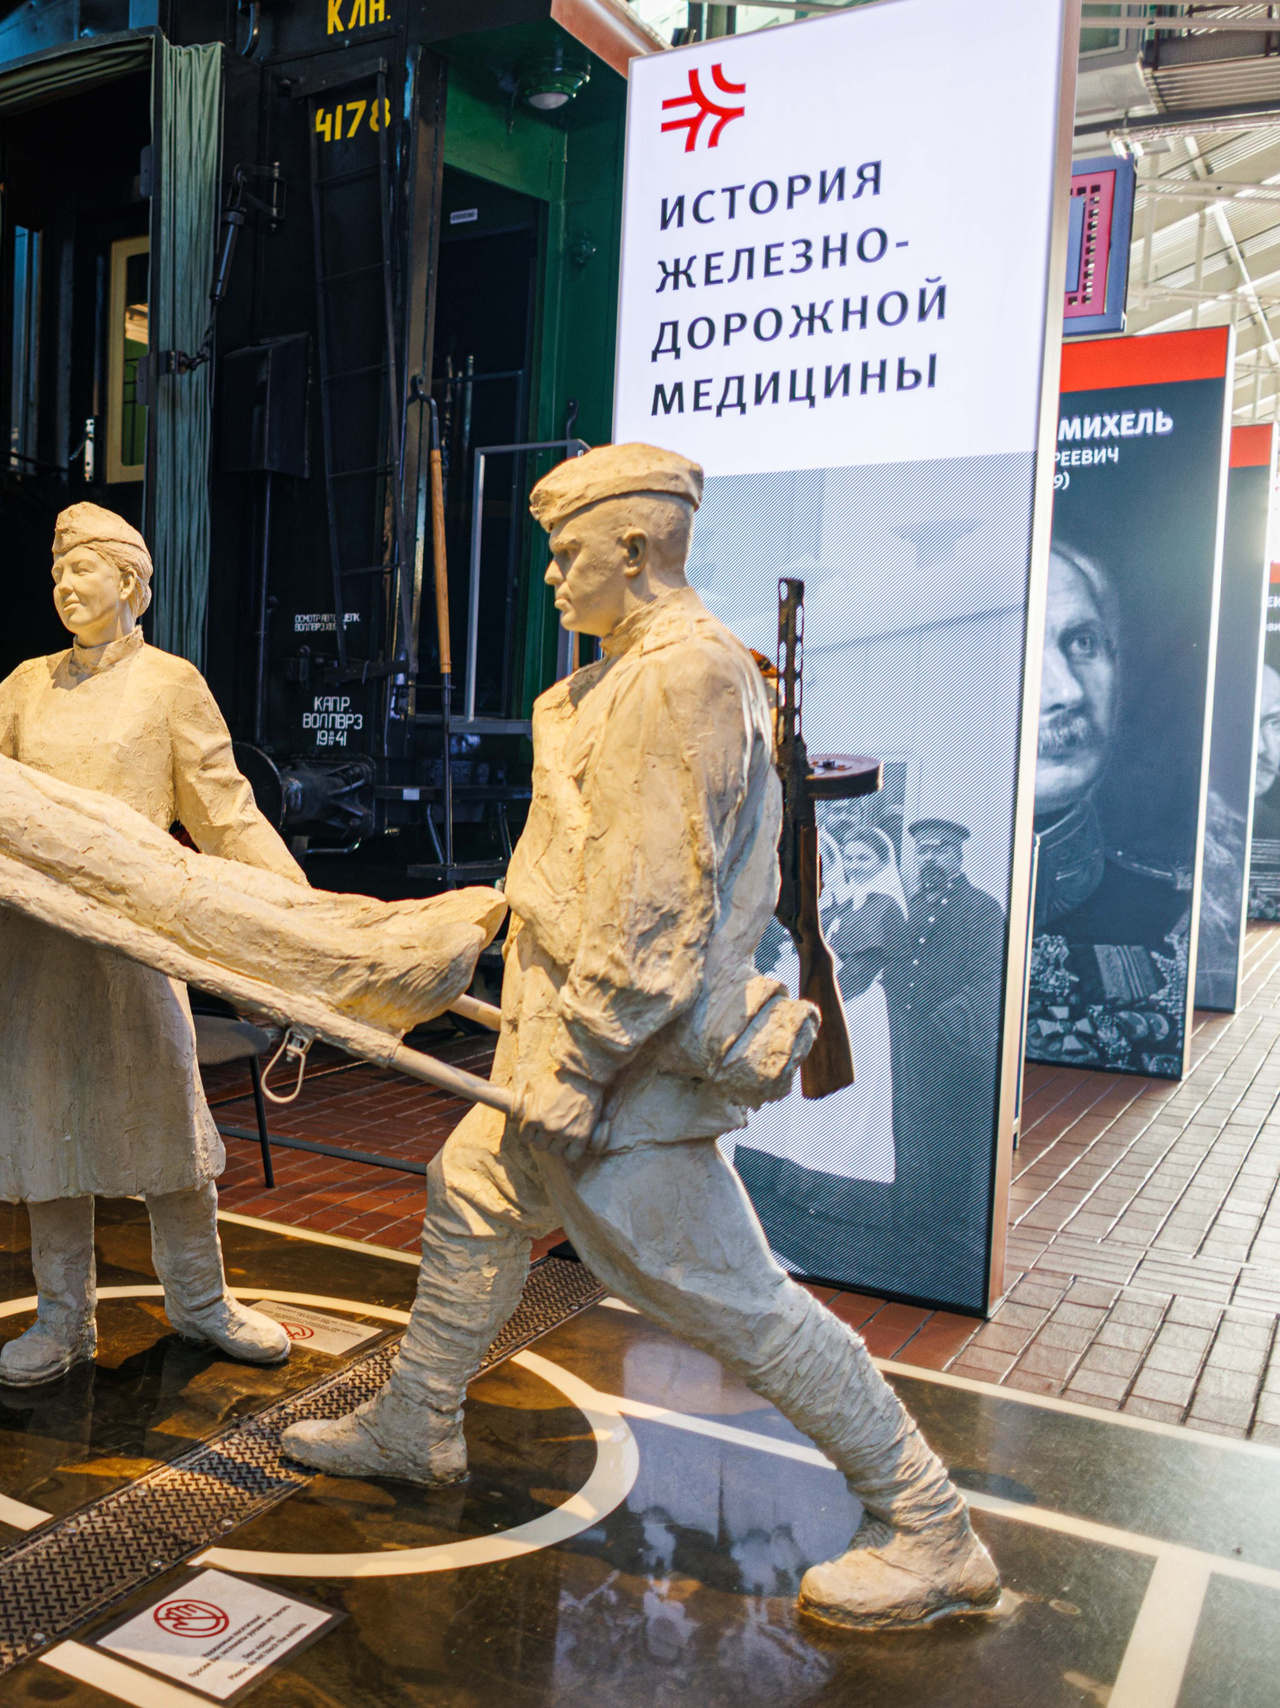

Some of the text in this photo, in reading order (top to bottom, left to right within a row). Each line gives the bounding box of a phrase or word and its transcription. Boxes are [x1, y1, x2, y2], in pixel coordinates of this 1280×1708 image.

[315, 97, 391, 143] 4178
[659, 160, 882, 231] ИСТОРИЯ
[655, 227, 909, 294] ЖЕЛЕЗНО-
[651, 275, 947, 363] ДОРОЖНОЙ
[651, 352, 938, 418] МЕДИЦИНЫ
[1057, 410, 1174, 441] МИХЕЛЬ
